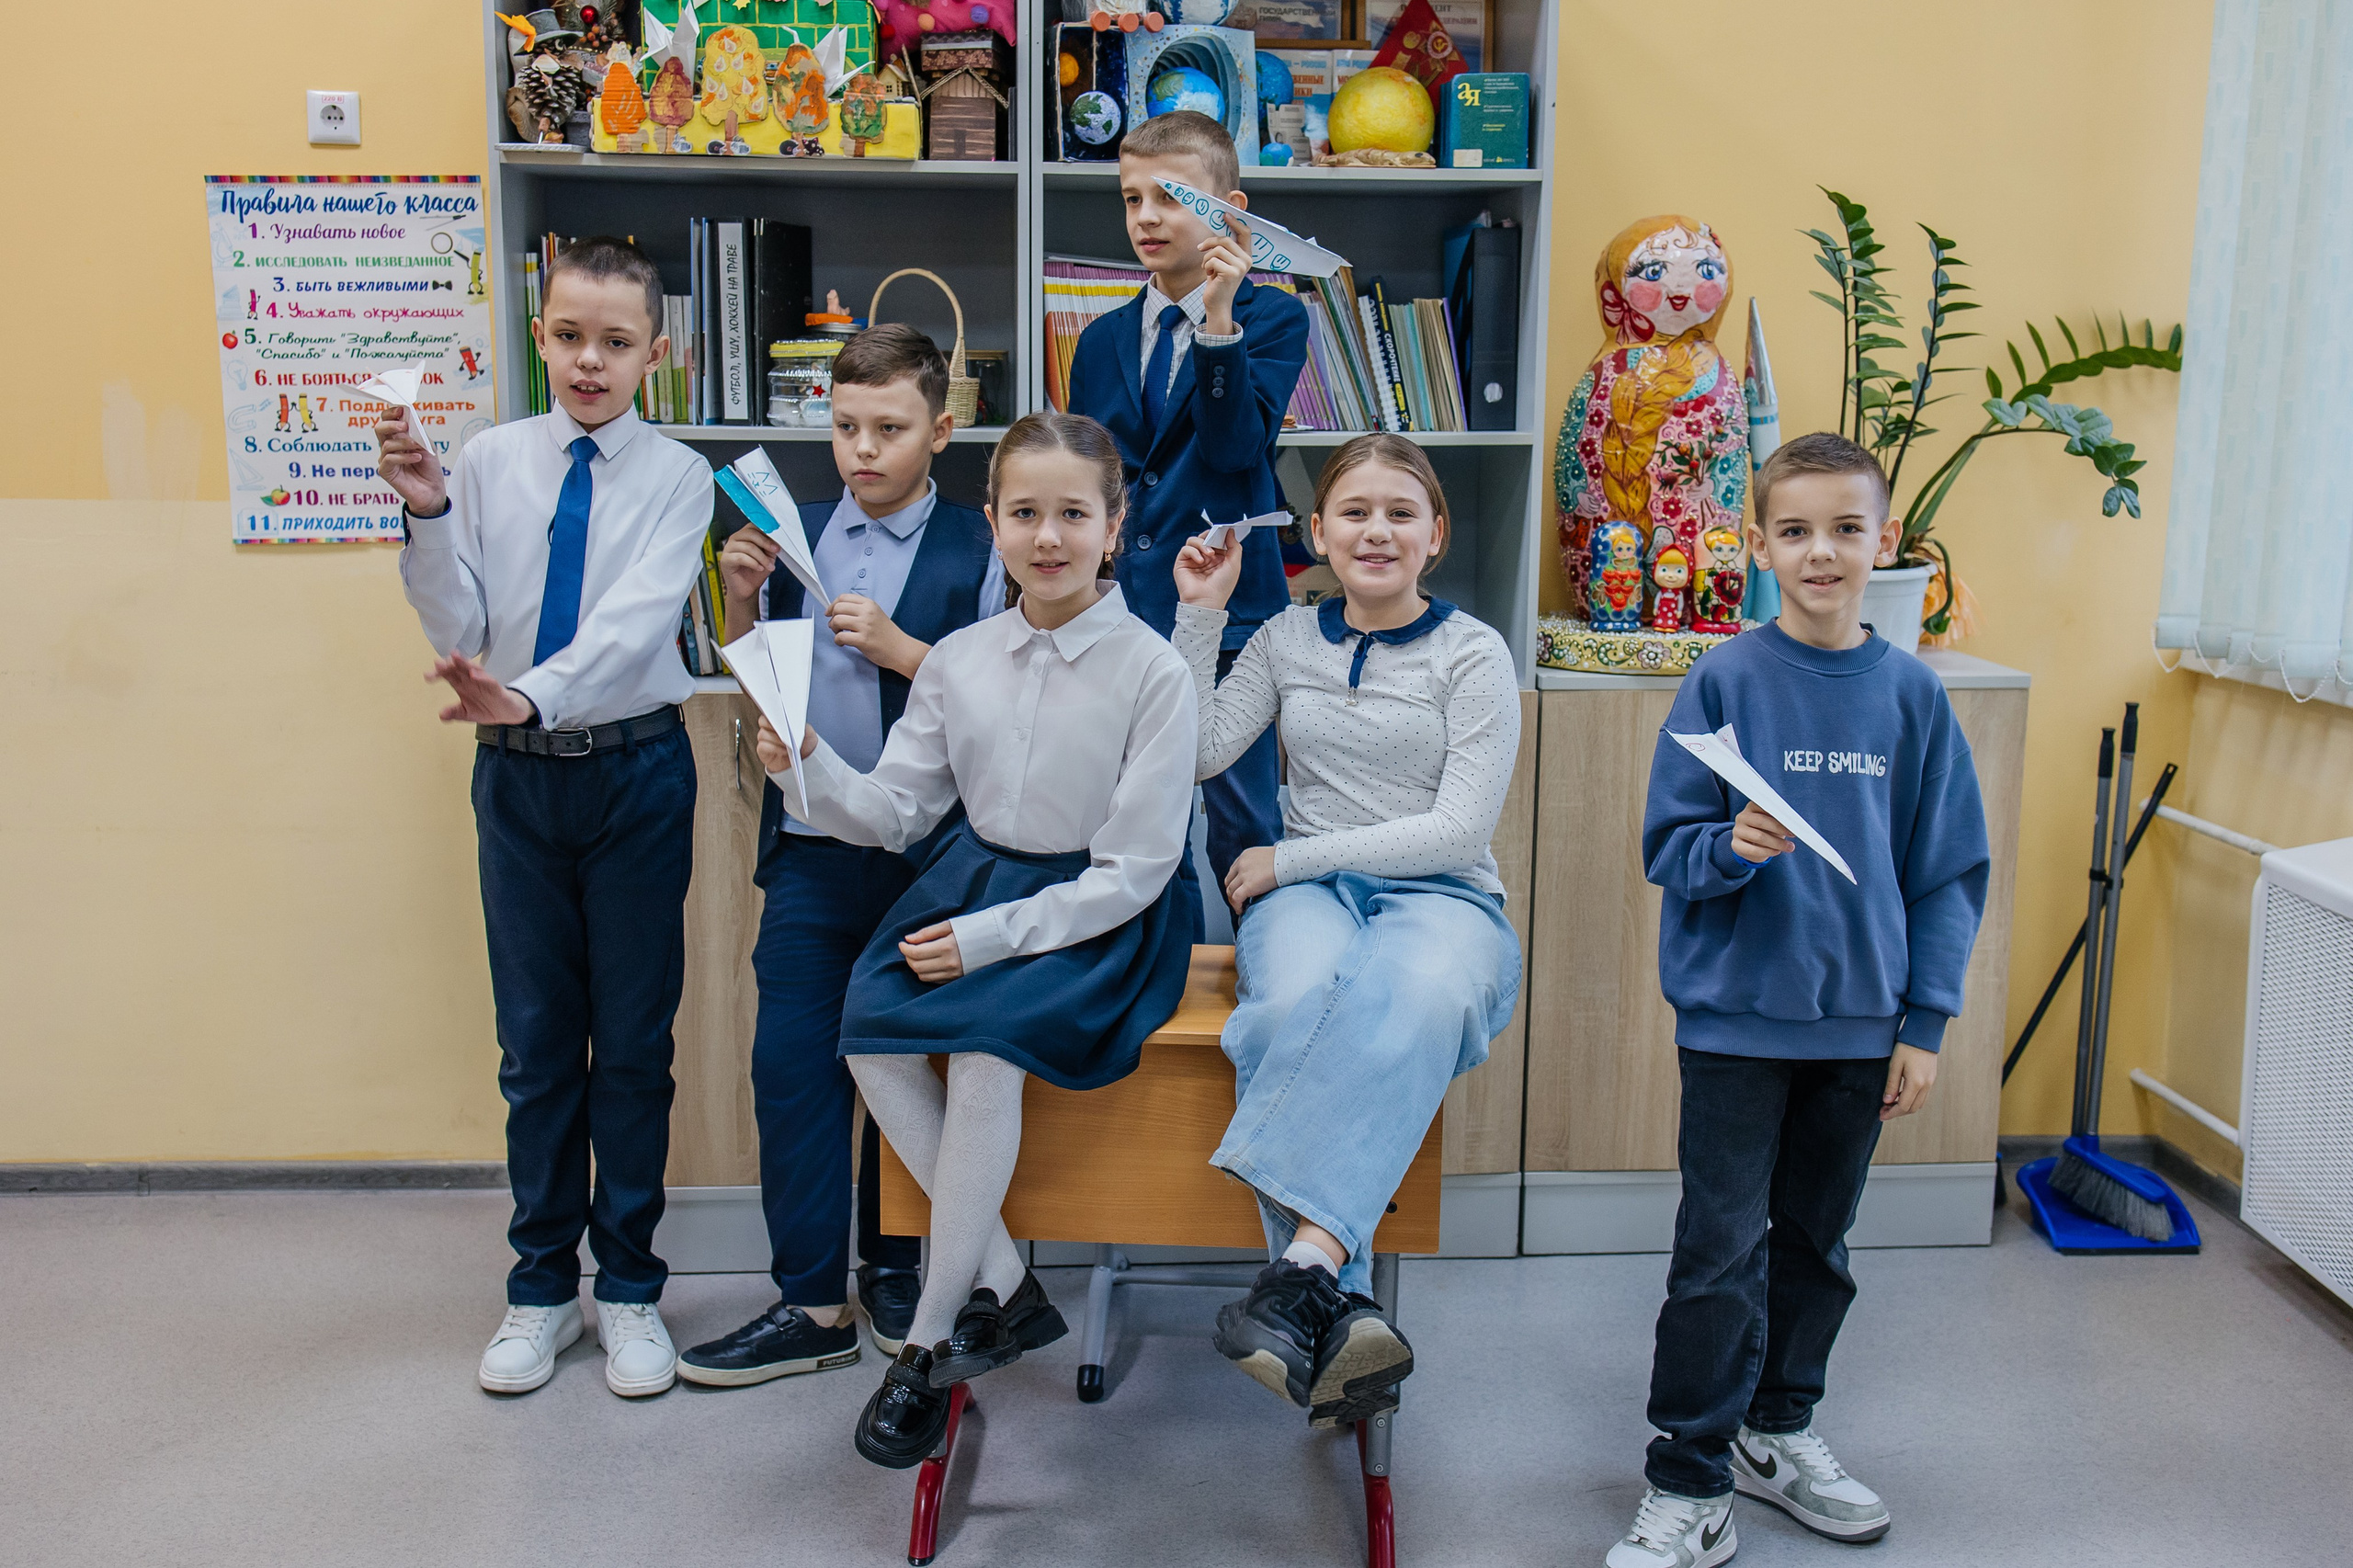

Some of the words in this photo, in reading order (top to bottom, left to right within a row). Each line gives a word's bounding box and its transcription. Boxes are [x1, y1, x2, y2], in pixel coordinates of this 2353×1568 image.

[222, 187, 318, 223] Правила
[323, 192, 398, 216] нашего
[404, 194, 479, 214] класса
[248, 222, 265, 239] 1.
[270, 223, 356, 244] Узнавать
[361, 223, 405, 239] новое
[233, 251, 251, 267] 2.
[256, 256, 347, 268] ИССЛЕДОВАТЬ
[356, 256, 454, 267] НЕИЗВЕДАННОЕ
[727, 244, 737, 273] ТРАВЕ
[273, 277, 290, 292] 3.
[296, 281, 332, 292] БЫТЬ
[337, 280, 429, 292] ВЕЖЛИВЫМИ
[728, 273, 738, 290] НА
[267, 302, 284, 318] 4.
[289, 302, 356, 319] Уважать
[364, 308, 464, 322] окружающих
[728, 292, 739, 334] ХОККЕЙ
[244, 328, 262, 344] 5.
[268, 332, 336, 347] Говорить
[256, 348, 326, 359] "Спасибо"
[345, 347, 449, 361] "Пожалуйста"
[729, 335, 741, 362] УШУ,
[1383, 333, 1402, 382] СКОРОЧТЕНИЕ
[255, 369, 272, 386] 6.
[278, 372, 297, 386] НЕ
[302, 372, 371, 386] БОЯТЬСЯ
[730, 361, 741, 405] ФУТБОЛ,
[316, 397, 334, 412] 7.
[348, 415, 381, 428] дру
[244, 436, 262, 452] 8.
[267, 437, 372, 452] Соблюдать
[289, 461, 307, 478] 9.
[312, 464, 336, 478] Не
[294, 490, 324, 506] 10.
[328, 494, 348, 506] НЕ
[353, 493, 400, 506] БРАТЬ
[247, 515, 277, 531] 11.
[282, 517, 373, 531] ПРИХОДИТЬ
[1784, 750, 1824, 772] KEEP
[1828, 751, 1887, 778] SMILING
